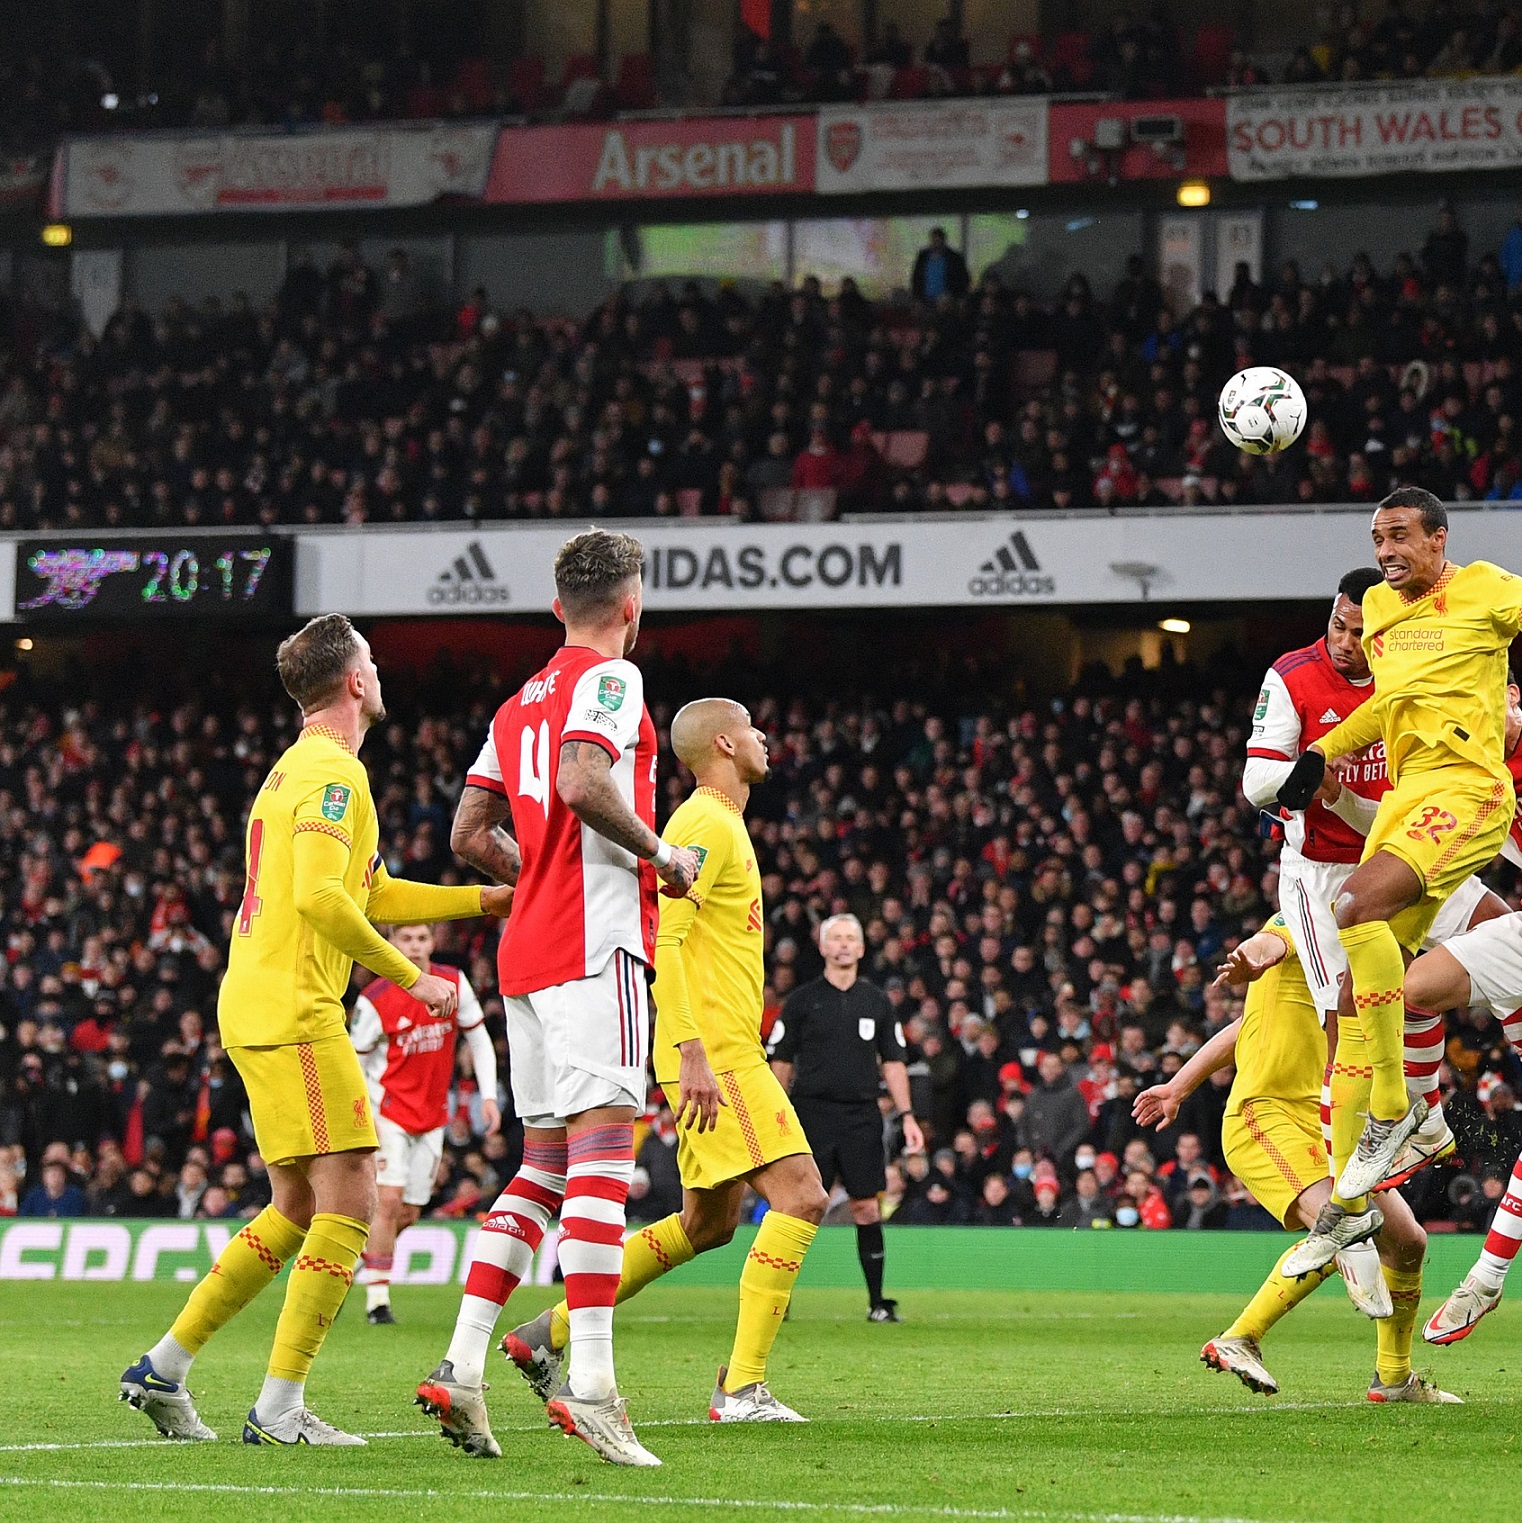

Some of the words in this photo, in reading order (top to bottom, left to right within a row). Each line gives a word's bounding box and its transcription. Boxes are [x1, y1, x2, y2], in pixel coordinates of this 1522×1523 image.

[1233, 114, 1362, 153] SOUTH
[1375, 106, 1502, 145] WALES
[593, 123, 796, 191] Arsenal
[426, 580, 511, 604] adidas
[968, 574, 1055, 597] adidas
[1388, 640, 1445, 652] chartered
[1389, 628, 1443, 641] standard
[518, 719, 549, 821] 4
[1410, 806, 1458, 846] 32
